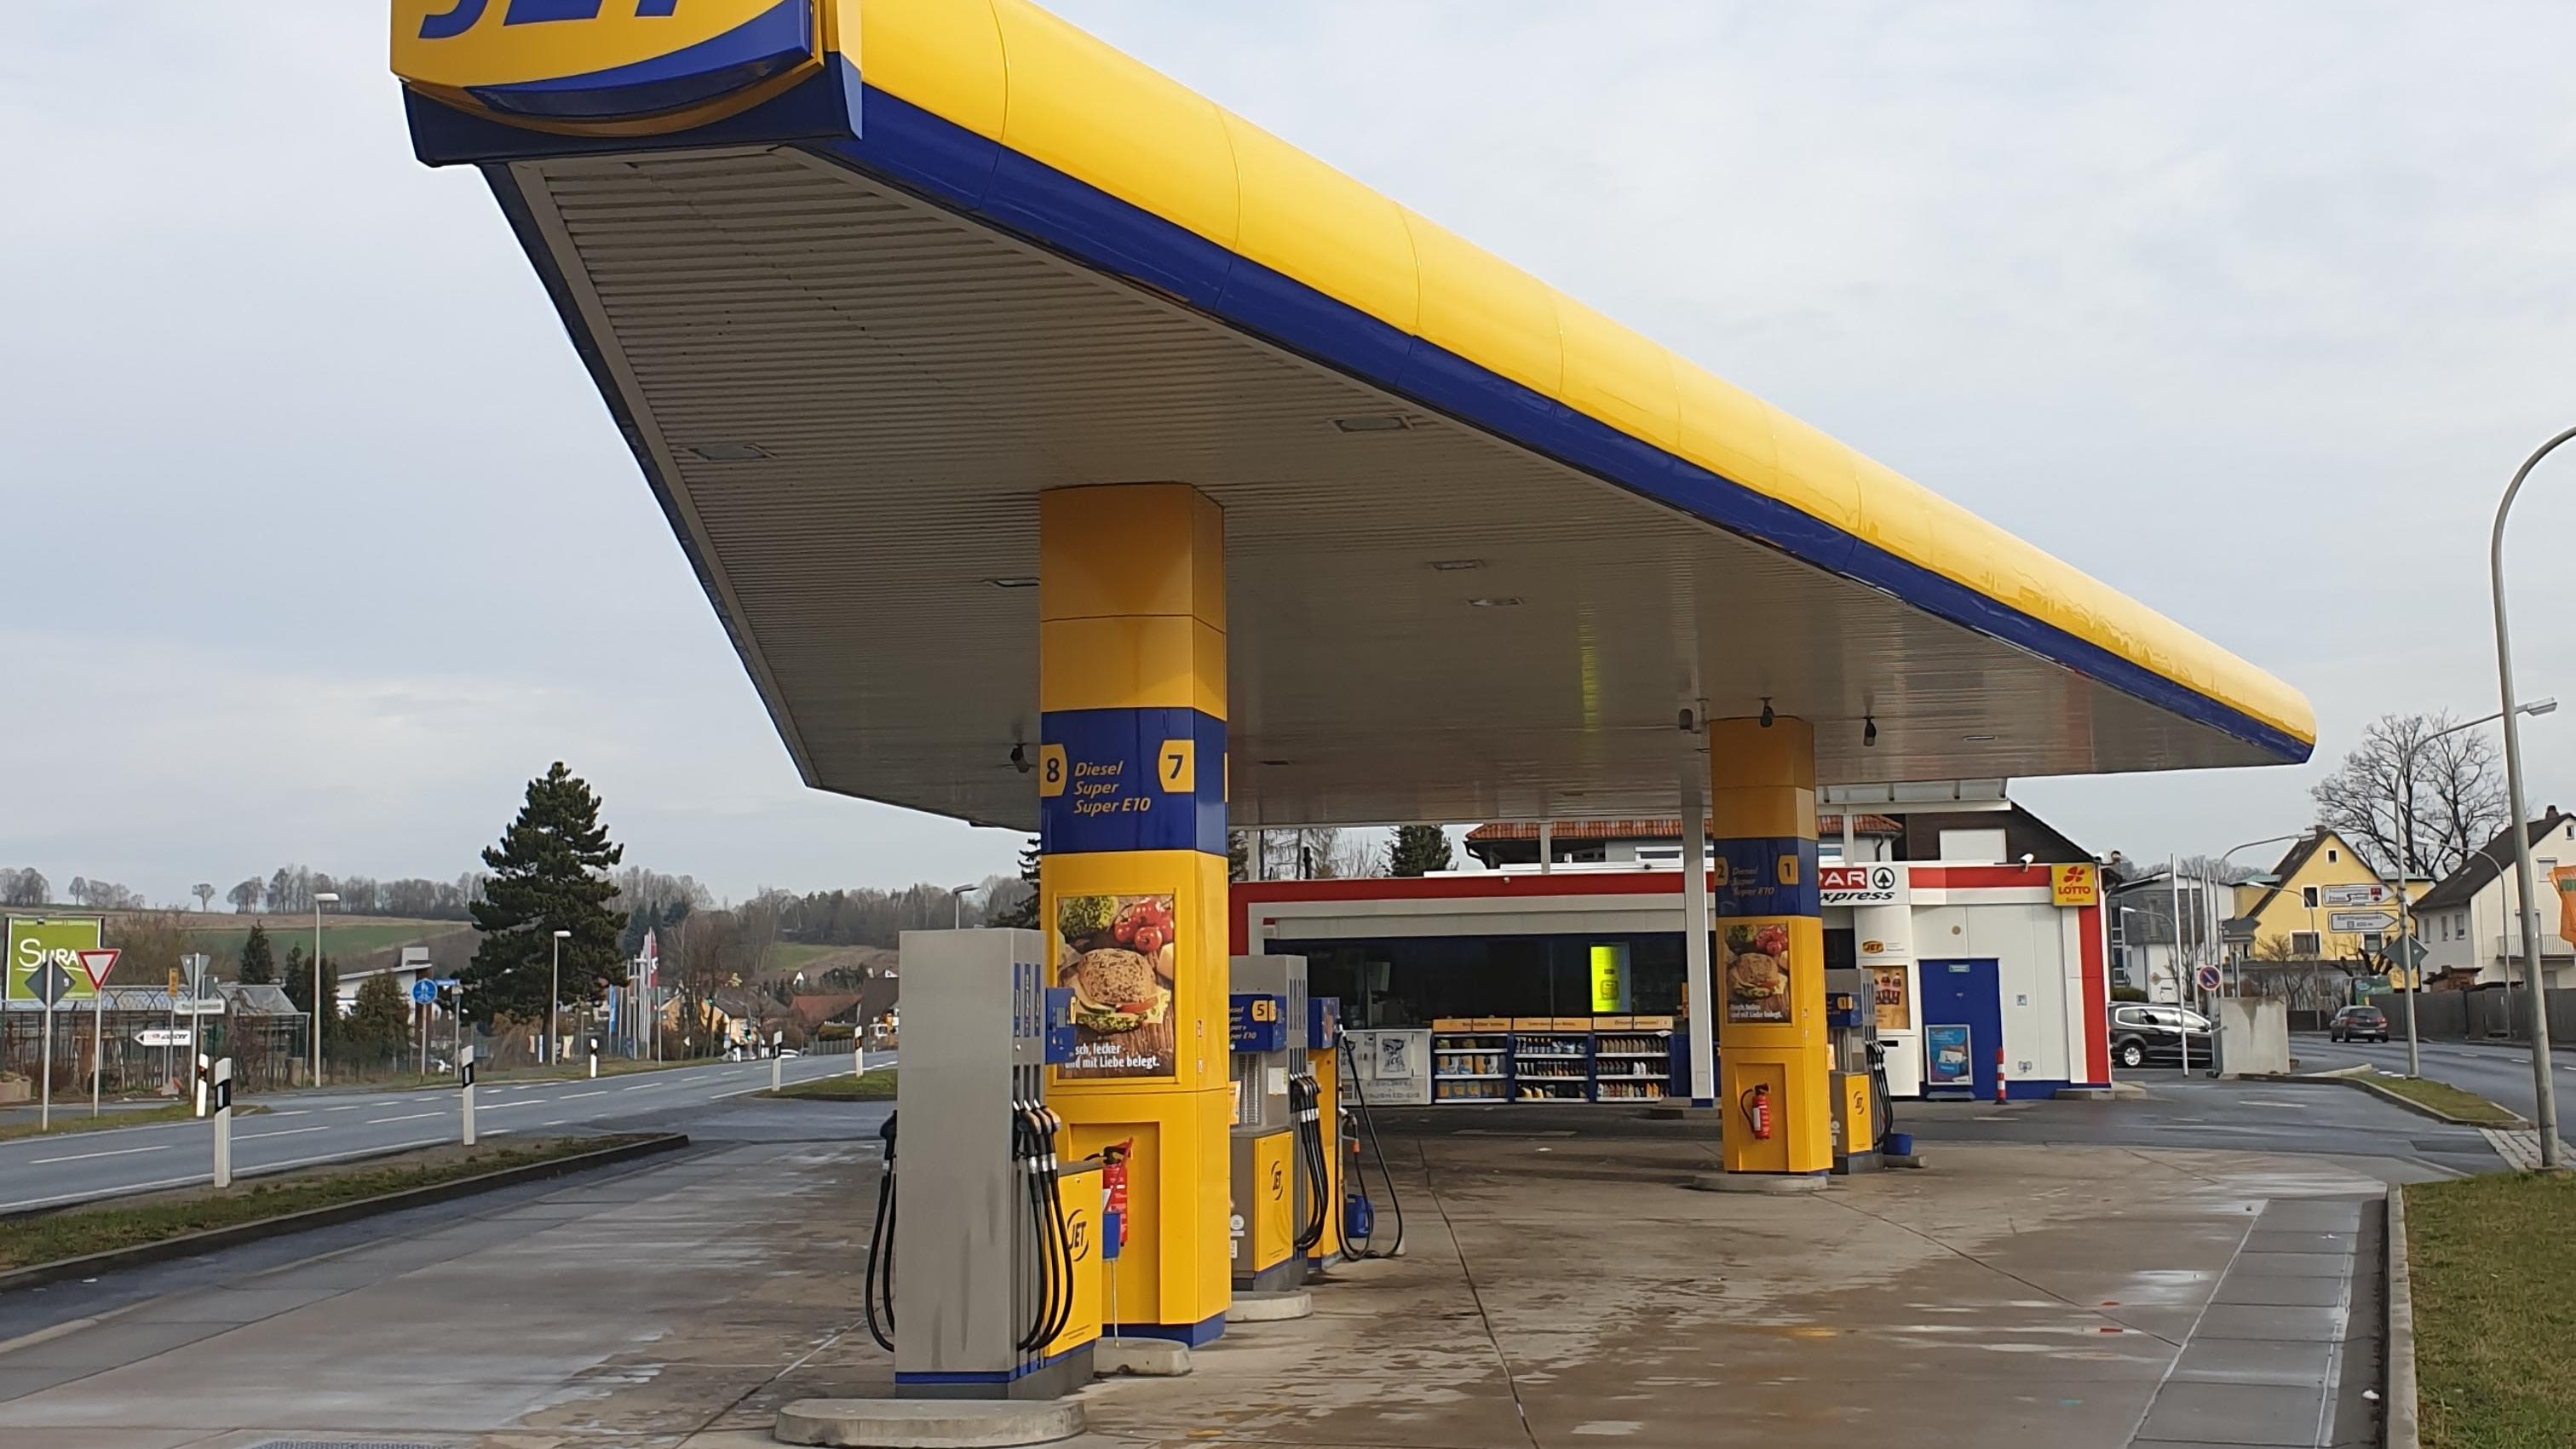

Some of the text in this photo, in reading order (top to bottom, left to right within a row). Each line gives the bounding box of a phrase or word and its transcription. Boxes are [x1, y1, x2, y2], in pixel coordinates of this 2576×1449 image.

[1045, 757, 1061, 783] 8
[1073, 760, 1124, 776] Diesel
[1168, 754, 1184, 779] 7
[1073, 780, 1119, 799] Super
[1073, 796, 1151, 817] Super E10
[1716, 865, 1726, 879] 2
[1783, 862, 1791, 878] 1
[1819, 871, 1866, 886] AR
[1820, 891, 1895, 903] xpress
[2057, 886, 2091, 895] LOTTO
[1866, 943, 1882, 952] JET
[1256, 1003, 1265, 1016] 5
[1093, 1042, 1122, 1055] lecker
[1083, 1056, 1098, 1068] mit
[1100, 1055, 1124, 1067] Liebe
[1126, 1055, 1160, 1069] belegt.
[1067, 1221, 1087, 1250] JET
